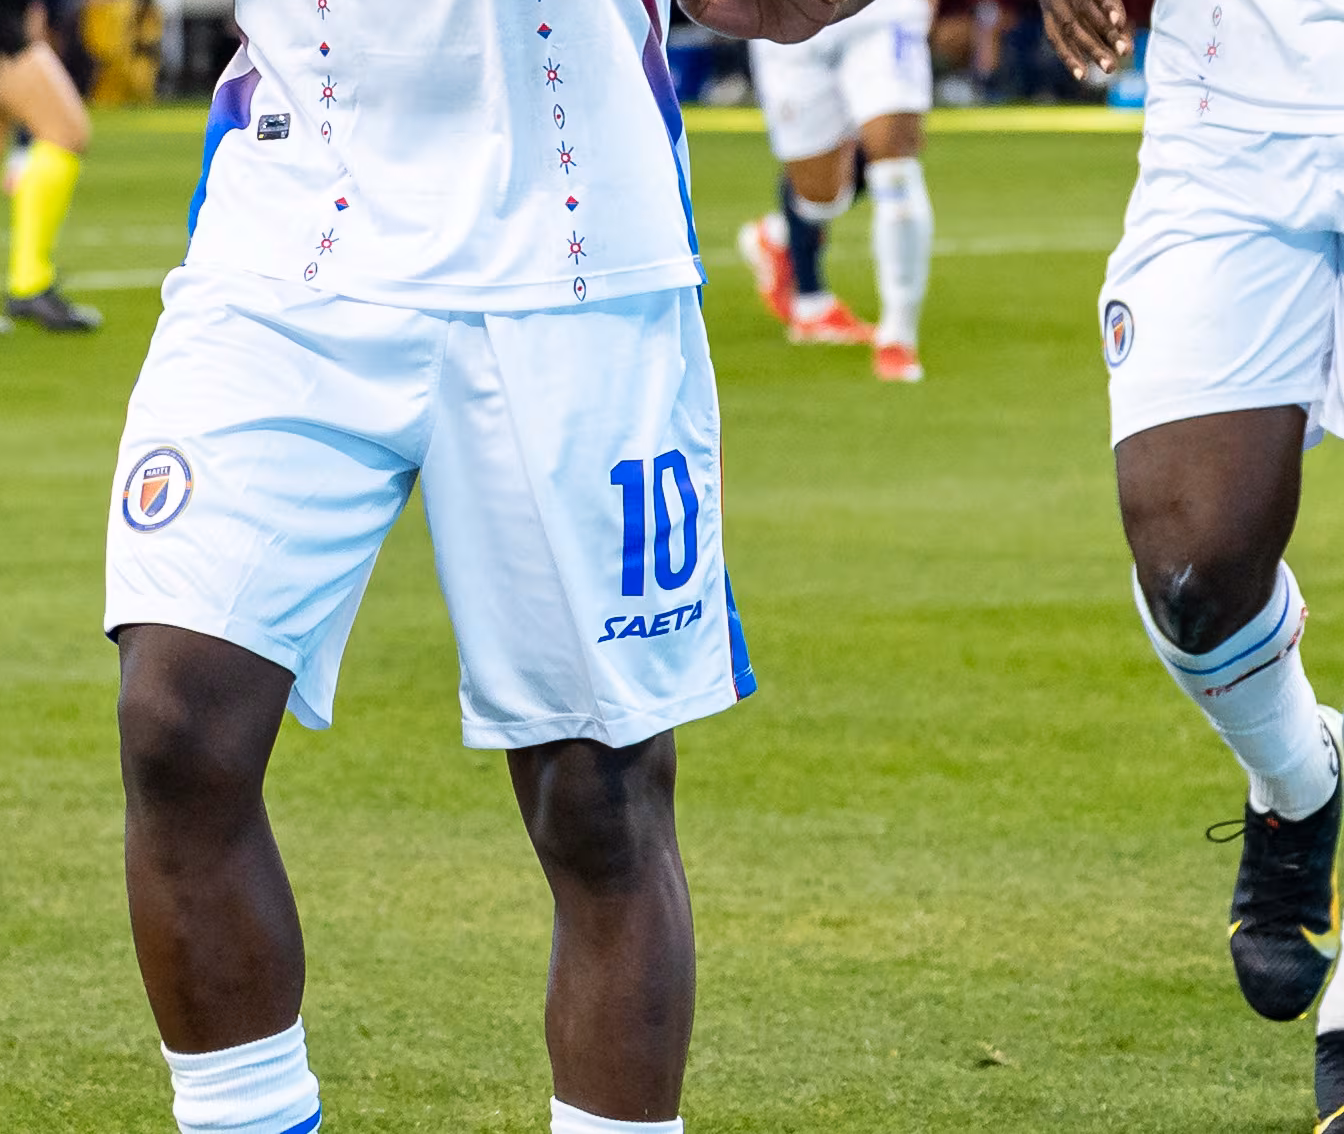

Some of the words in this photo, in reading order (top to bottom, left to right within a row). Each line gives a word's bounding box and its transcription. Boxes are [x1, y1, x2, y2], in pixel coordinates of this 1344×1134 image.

[145, 466, 169, 477] HAITI
[610, 449, 699, 596] 10
[597, 599, 702, 643] SAETA
